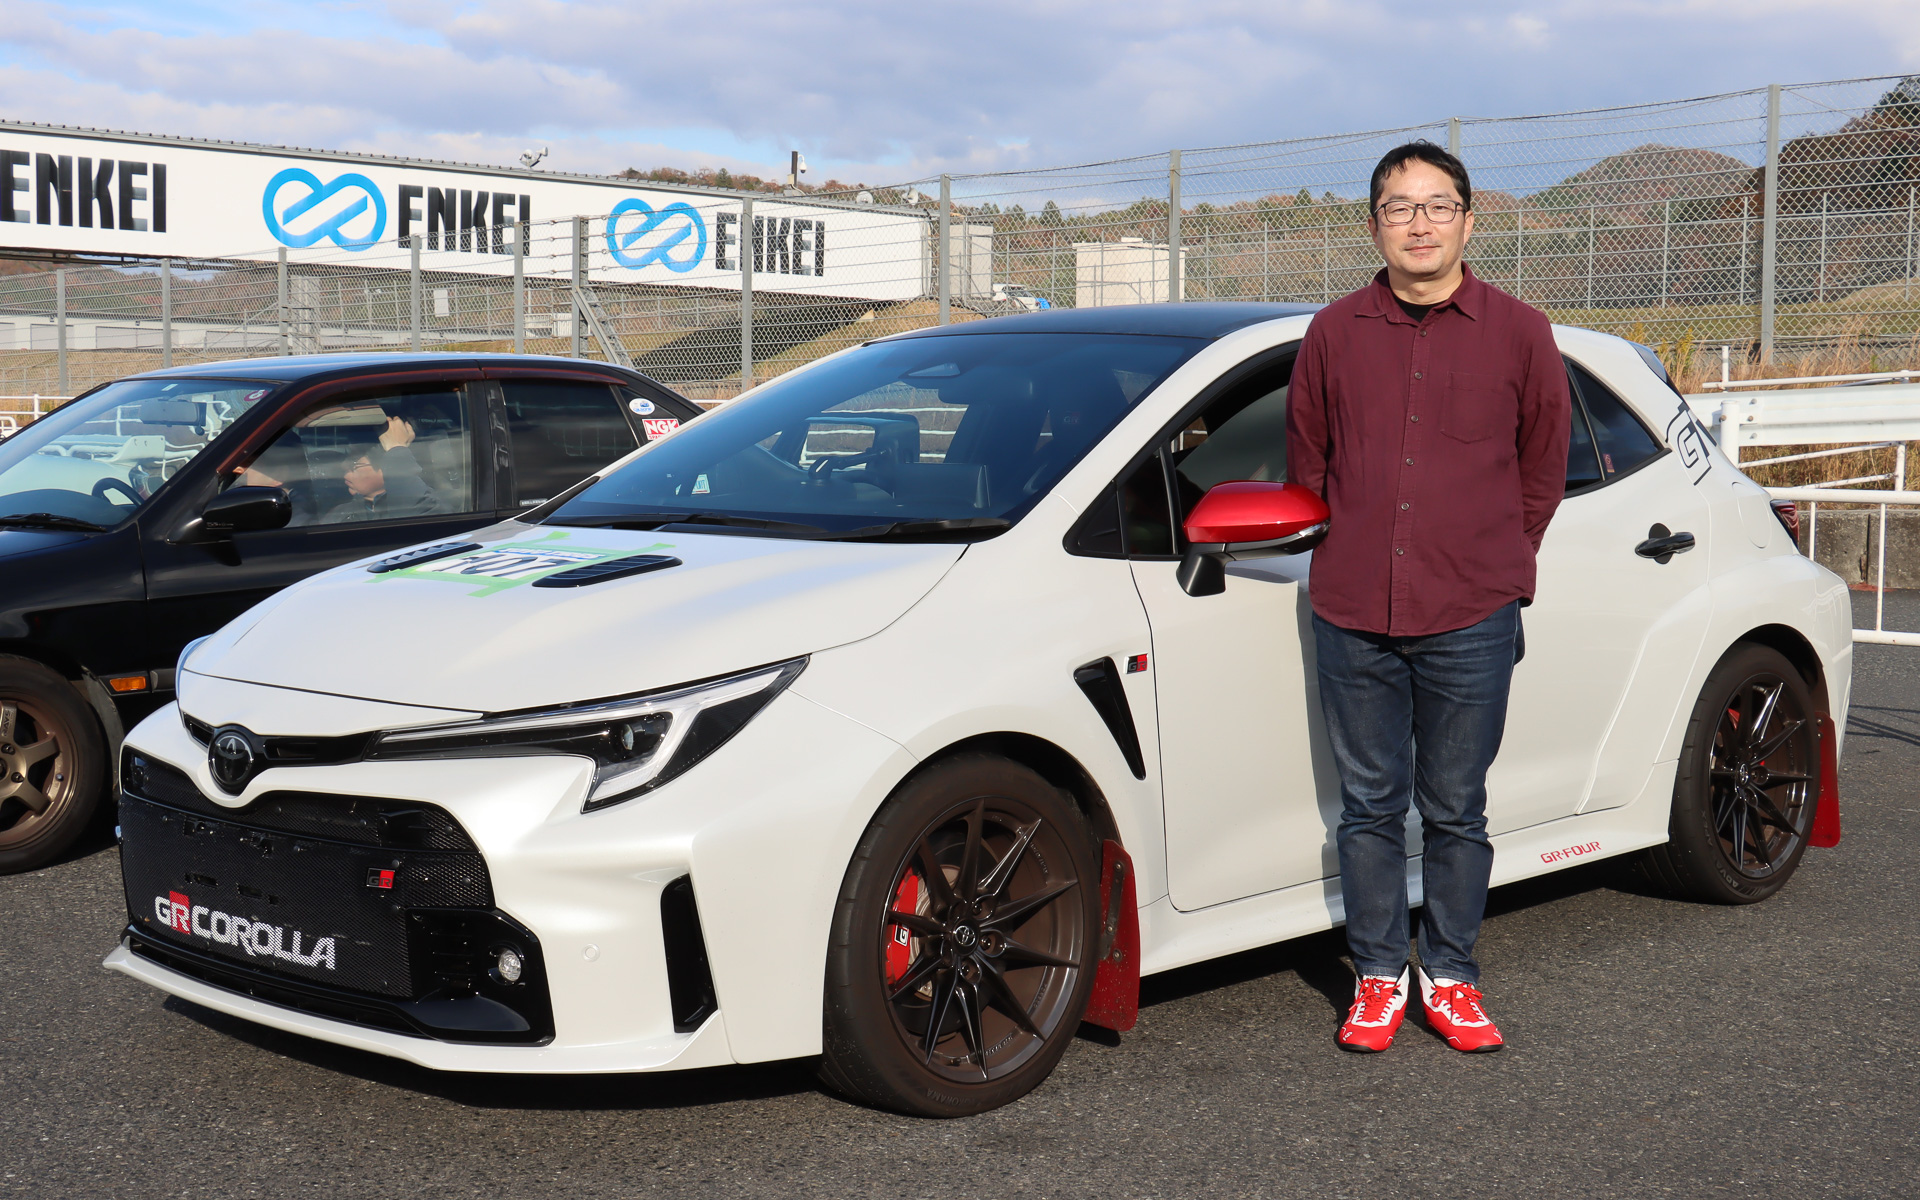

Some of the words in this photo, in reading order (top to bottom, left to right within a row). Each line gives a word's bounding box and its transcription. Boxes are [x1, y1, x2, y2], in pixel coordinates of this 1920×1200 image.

[0, 149, 167, 233] ENKEI
[398, 183, 531, 257] ENKEI
[715, 211, 825, 277] ENKEI
[644, 420, 678, 434] NGK
[191, 905, 336, 971] COROLLA
